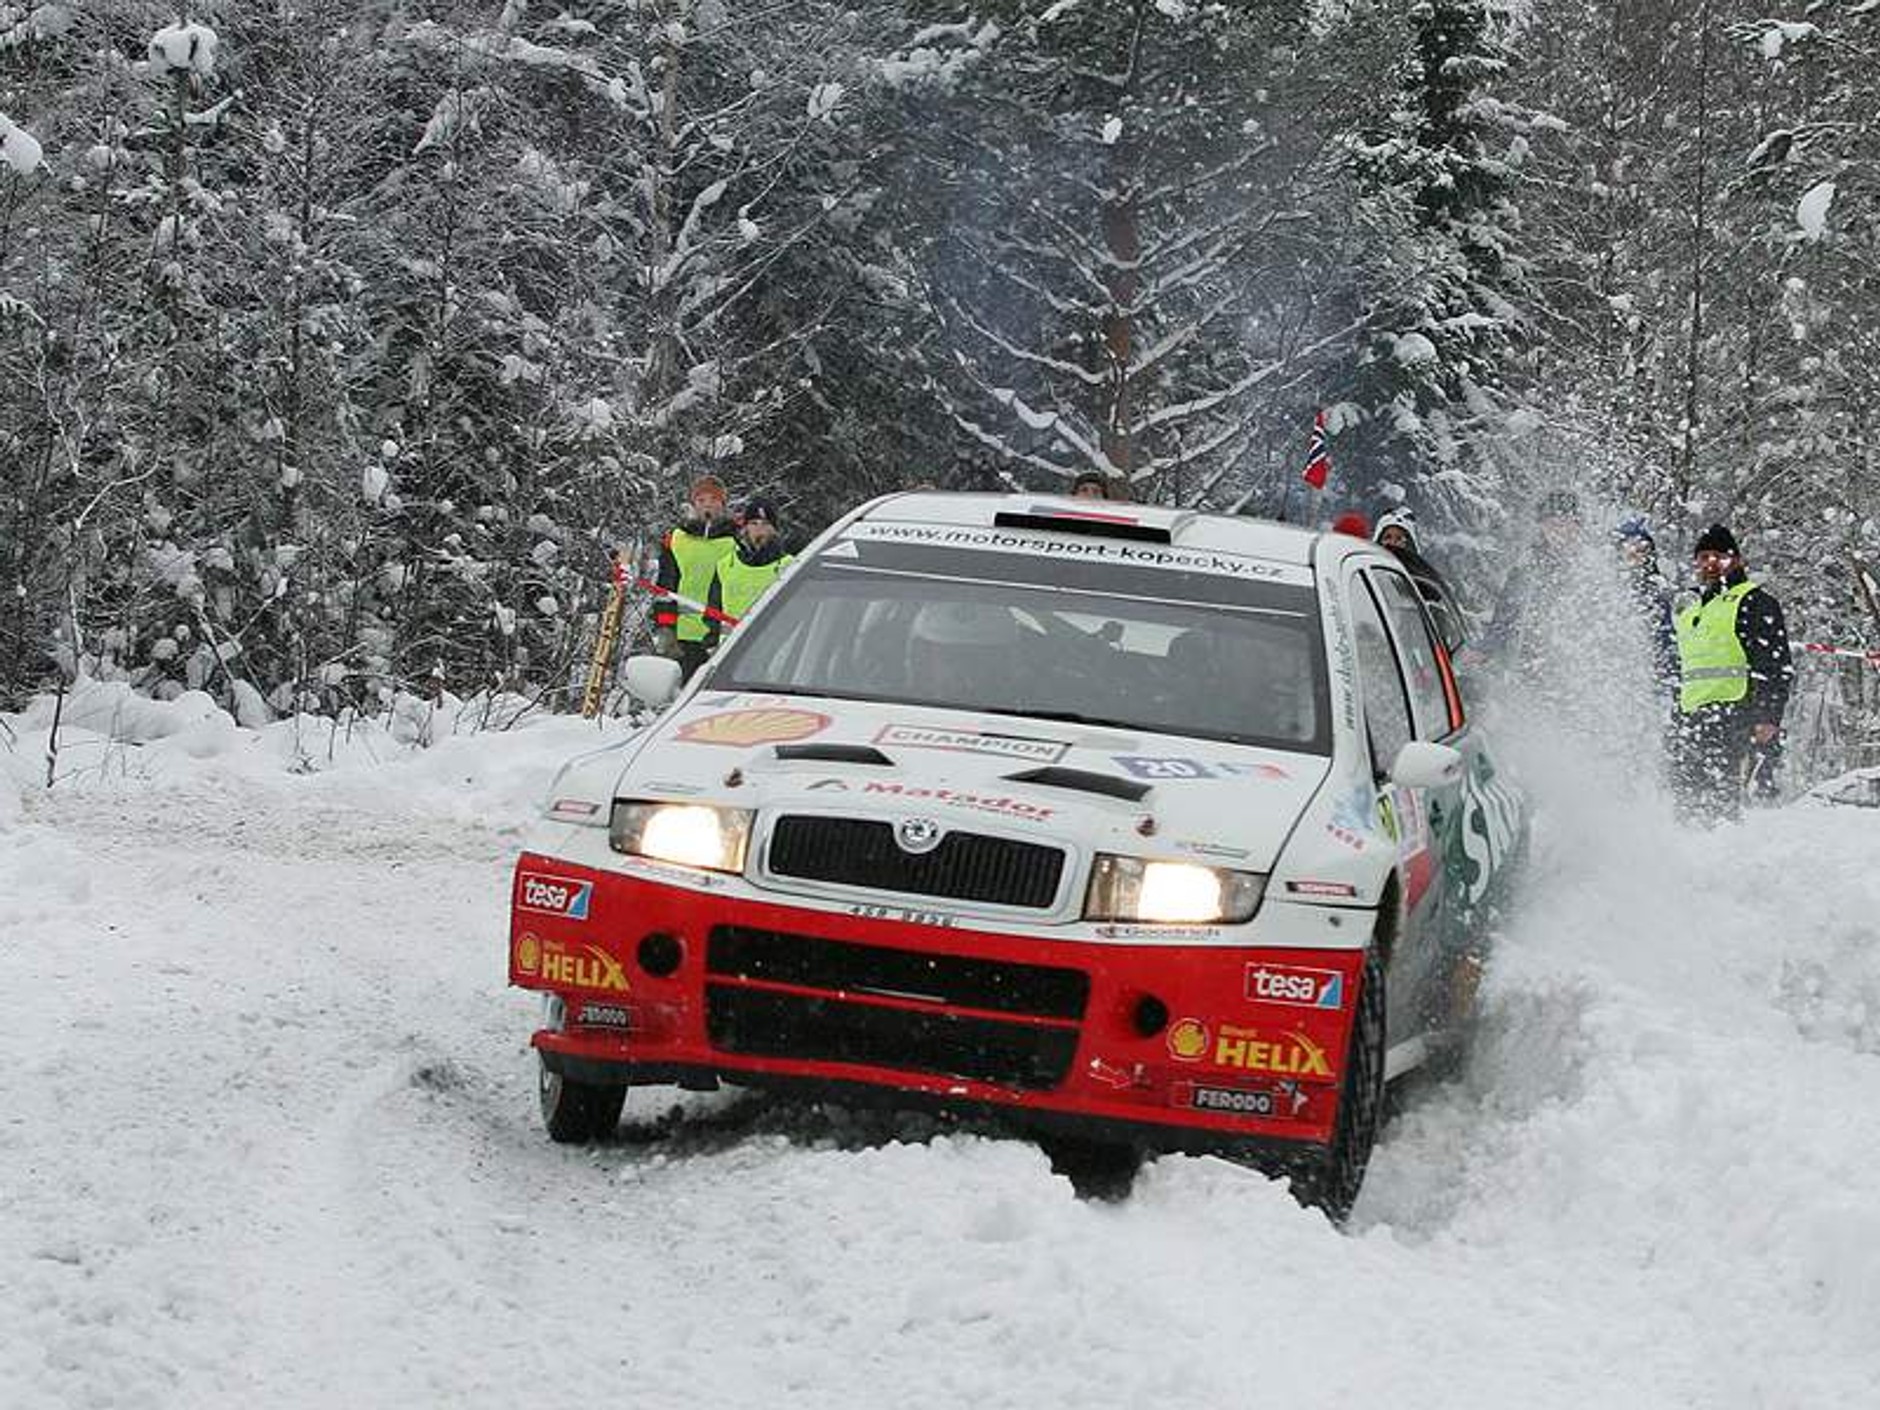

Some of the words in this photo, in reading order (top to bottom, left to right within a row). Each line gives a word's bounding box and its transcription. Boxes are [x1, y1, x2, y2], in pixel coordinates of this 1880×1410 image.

[869, 525, 1285, 578] www.motorsport-kopecky.cz
[891, 729, 1057, 757] CHAMPION
[1136, 760, 1198, 778] 20
[862, 781, 1056, 818] Matador
[525, 878, 568, 908] tesa
[542, 946, 631, 991] HELIX
[1253, 968, 1316, 999] tesa
[1214, 1032, 1332, 1076] HELIX
[1195, 1089, 1271, 1113] FERODO
